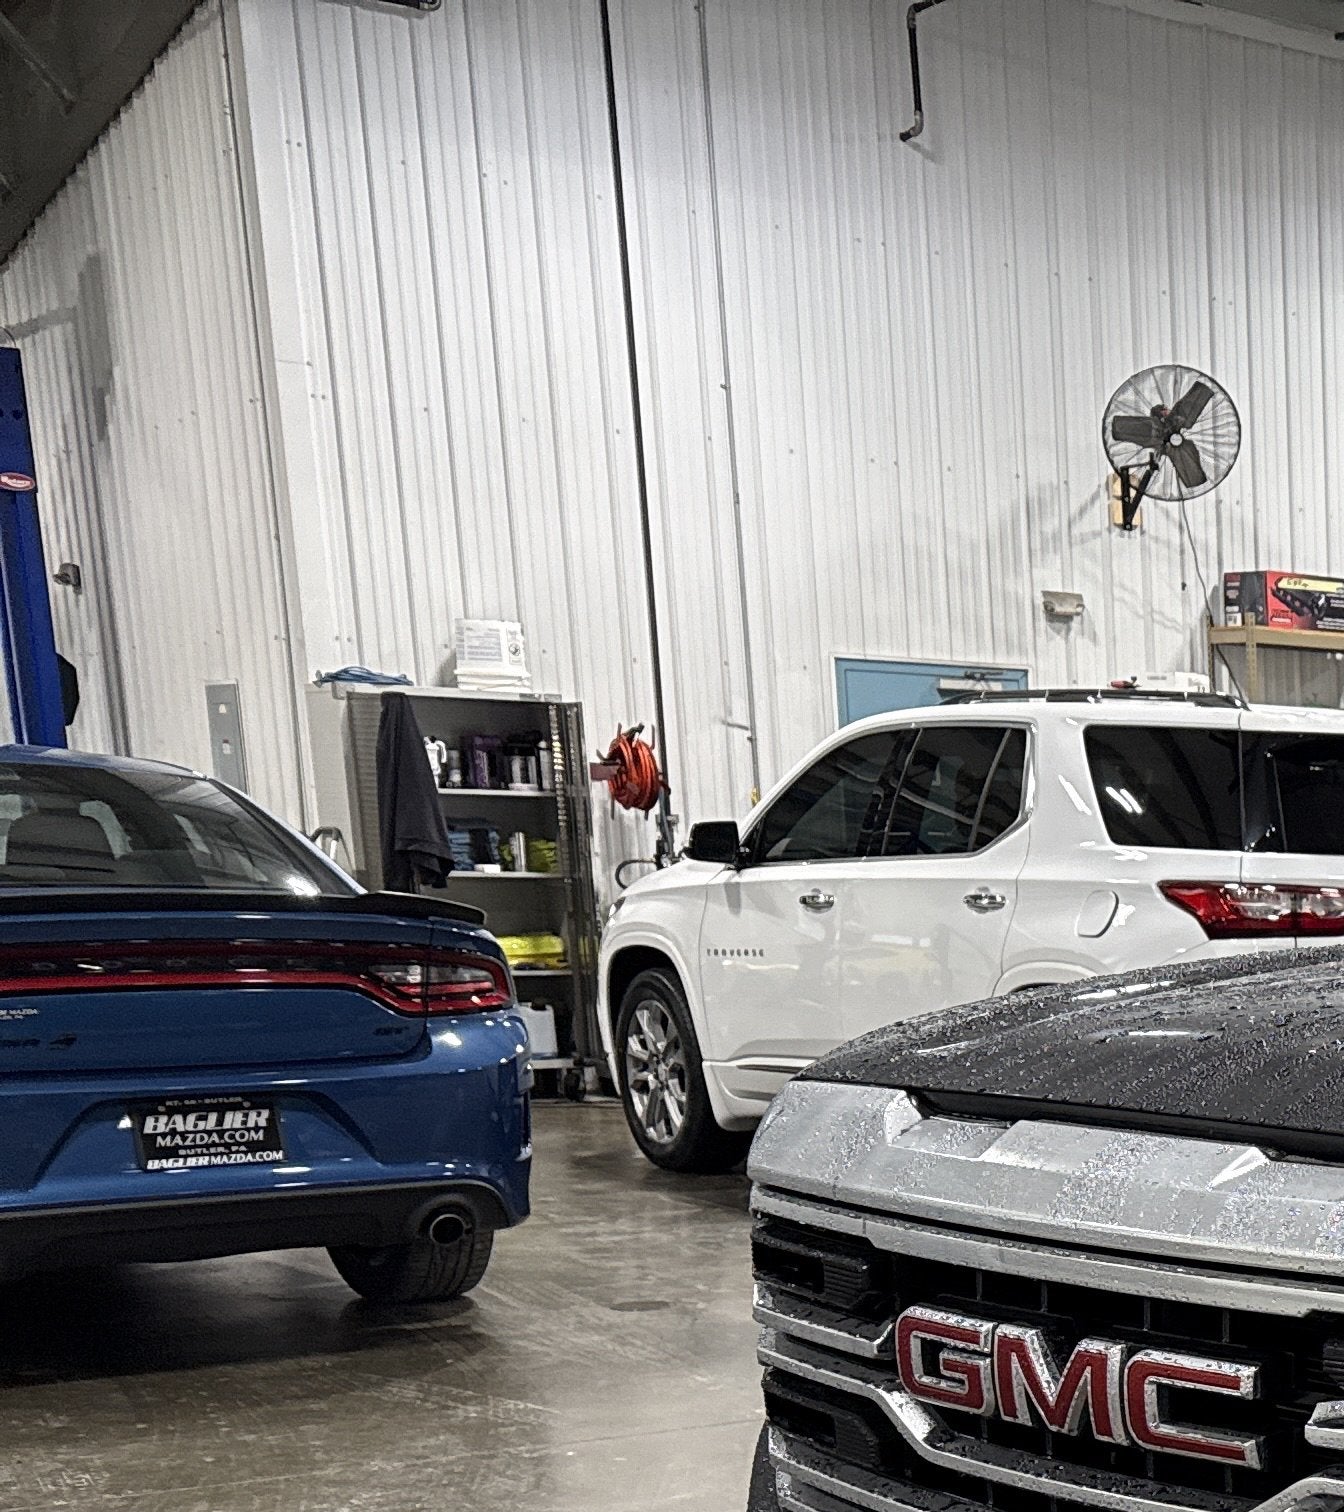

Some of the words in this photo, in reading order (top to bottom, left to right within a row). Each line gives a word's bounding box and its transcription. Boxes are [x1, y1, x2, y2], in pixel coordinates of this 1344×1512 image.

[142, 1108, 270, 1135] BAGLIER
[155, 1128, 265, 1148] MAZDA.COM
[895, 1305, 1262, 1471] GMC
